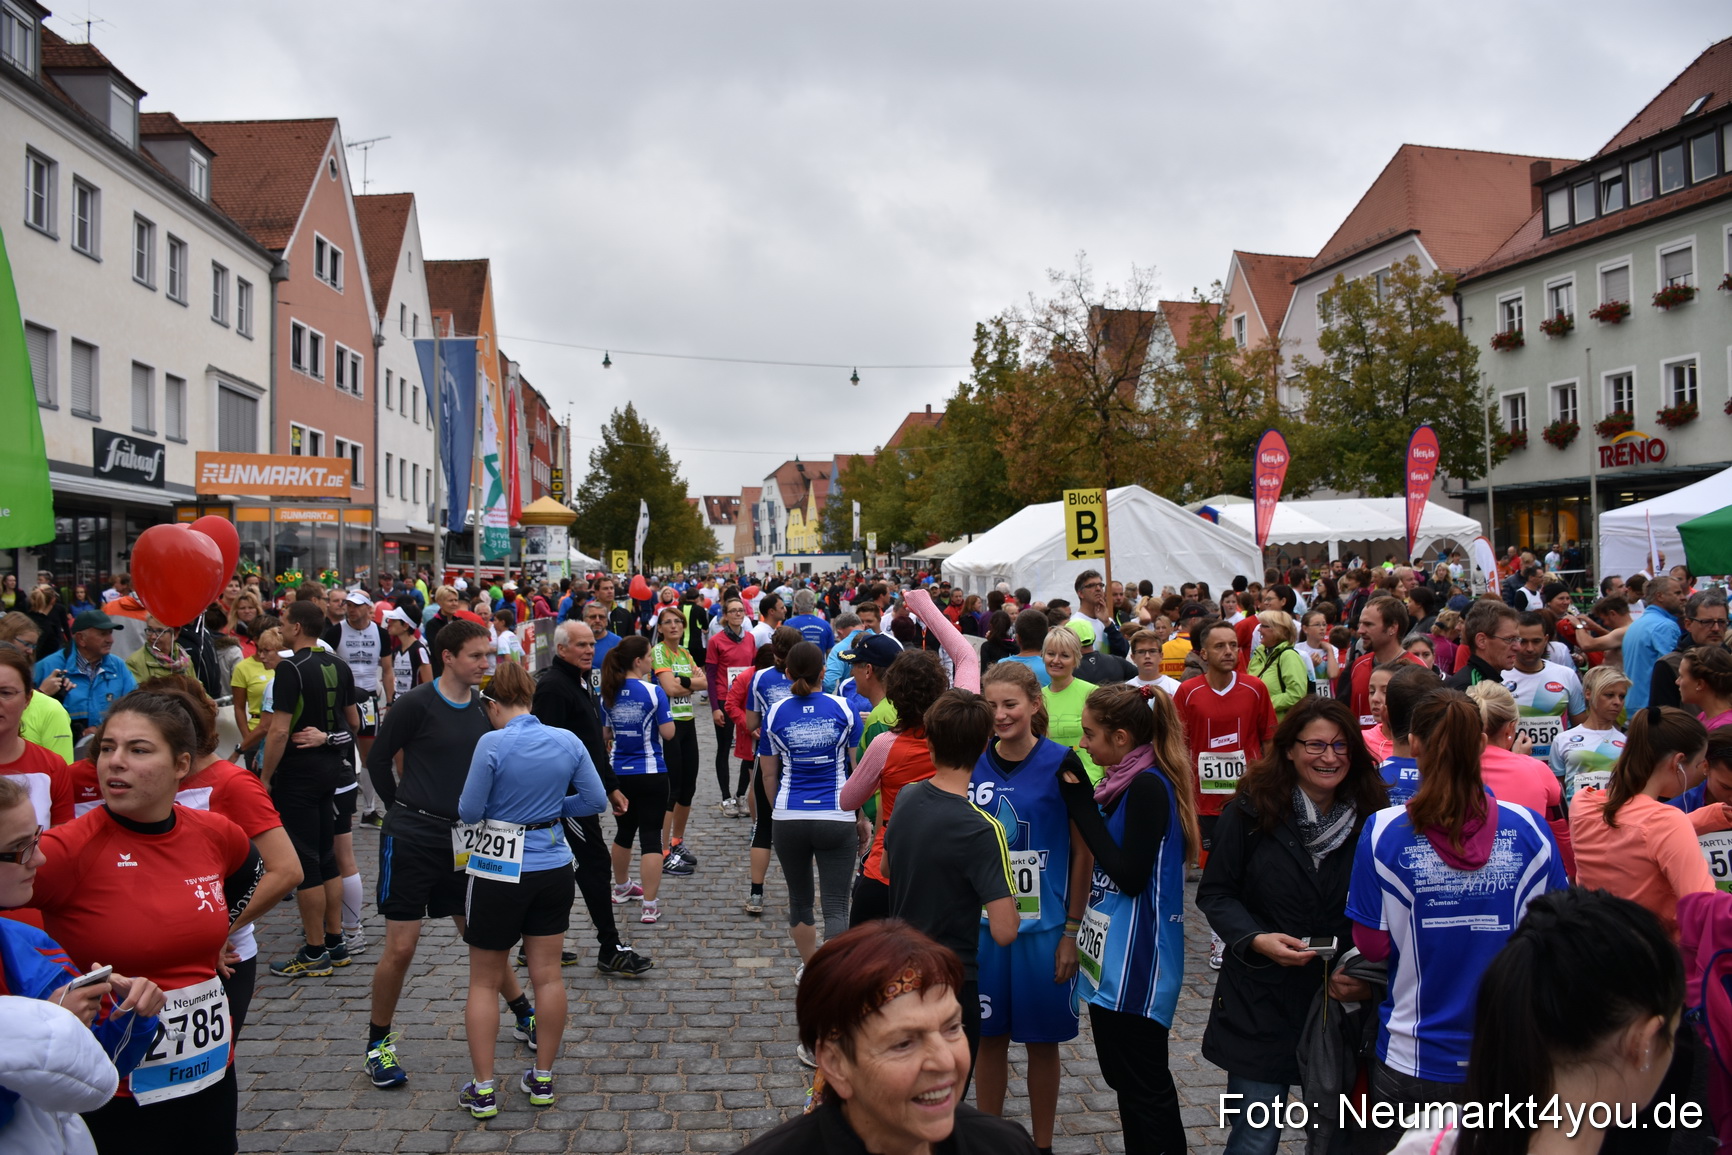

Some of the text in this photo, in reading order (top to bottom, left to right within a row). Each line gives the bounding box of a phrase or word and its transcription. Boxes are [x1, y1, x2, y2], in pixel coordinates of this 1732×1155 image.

[1598, 438, 1667, 469] RENO
[201, 463, 345, 488] RUNMARKT.DE
[1068, 491, 1103, 506] Block
[1076, 510, 1099, 545] B
[615, 557, 625, 569] C
[1204, 761, 1244, 779] 5100
[487, 825, 514, 835] Neumarkt
[475, 831, 517, 859] 2291
[477, 860, 503, 873] Nadine
[184, 878, 199, 886] TSV
[173, 988, 218, 1010] Neumarkt
[145, 1001, 225, 1062] 2785
[169, 1056, 210, 1083] Franzi
